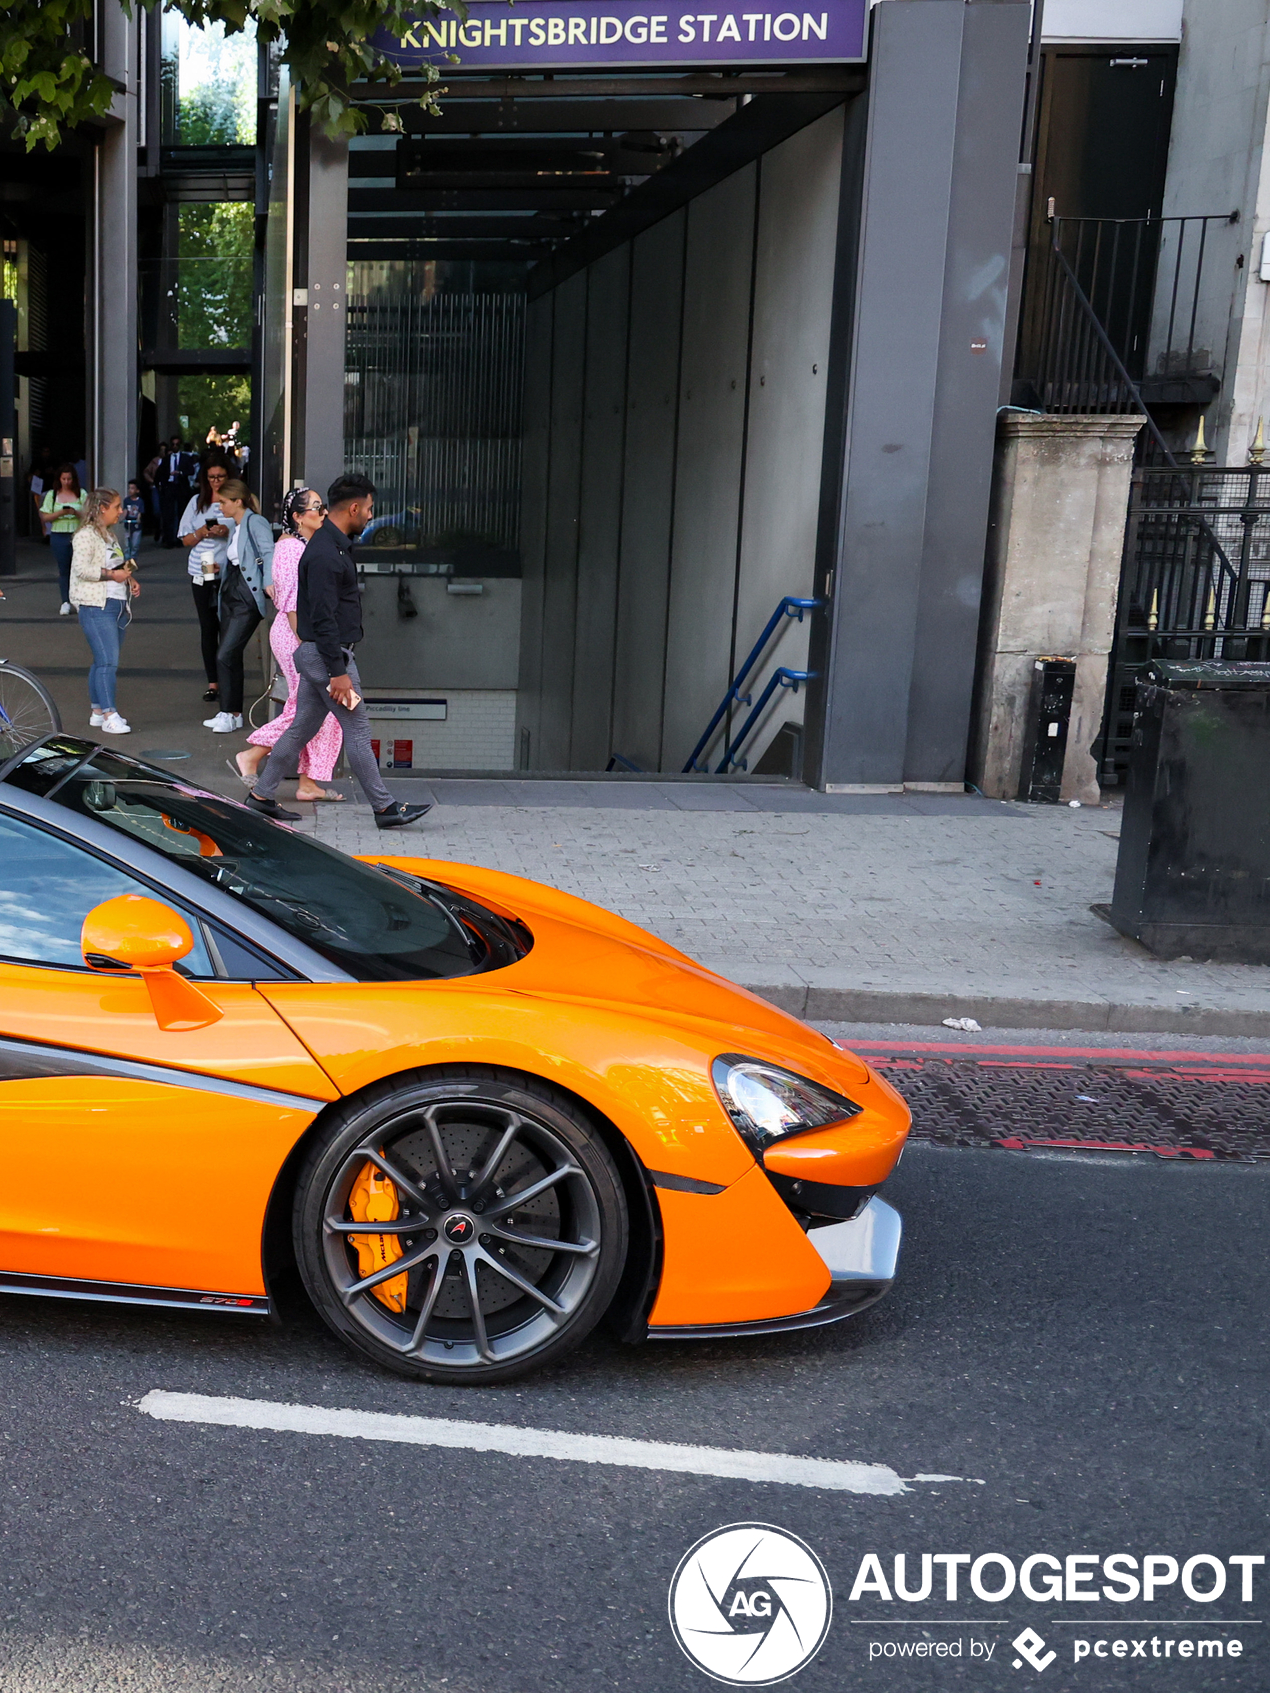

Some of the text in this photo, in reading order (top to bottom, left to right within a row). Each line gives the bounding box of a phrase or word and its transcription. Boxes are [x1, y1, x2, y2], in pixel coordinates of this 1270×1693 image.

[400, 12, 829, 49] KNIGHTSBRIDGE STATION
[365, 704, 396, 713] Piccadilly
